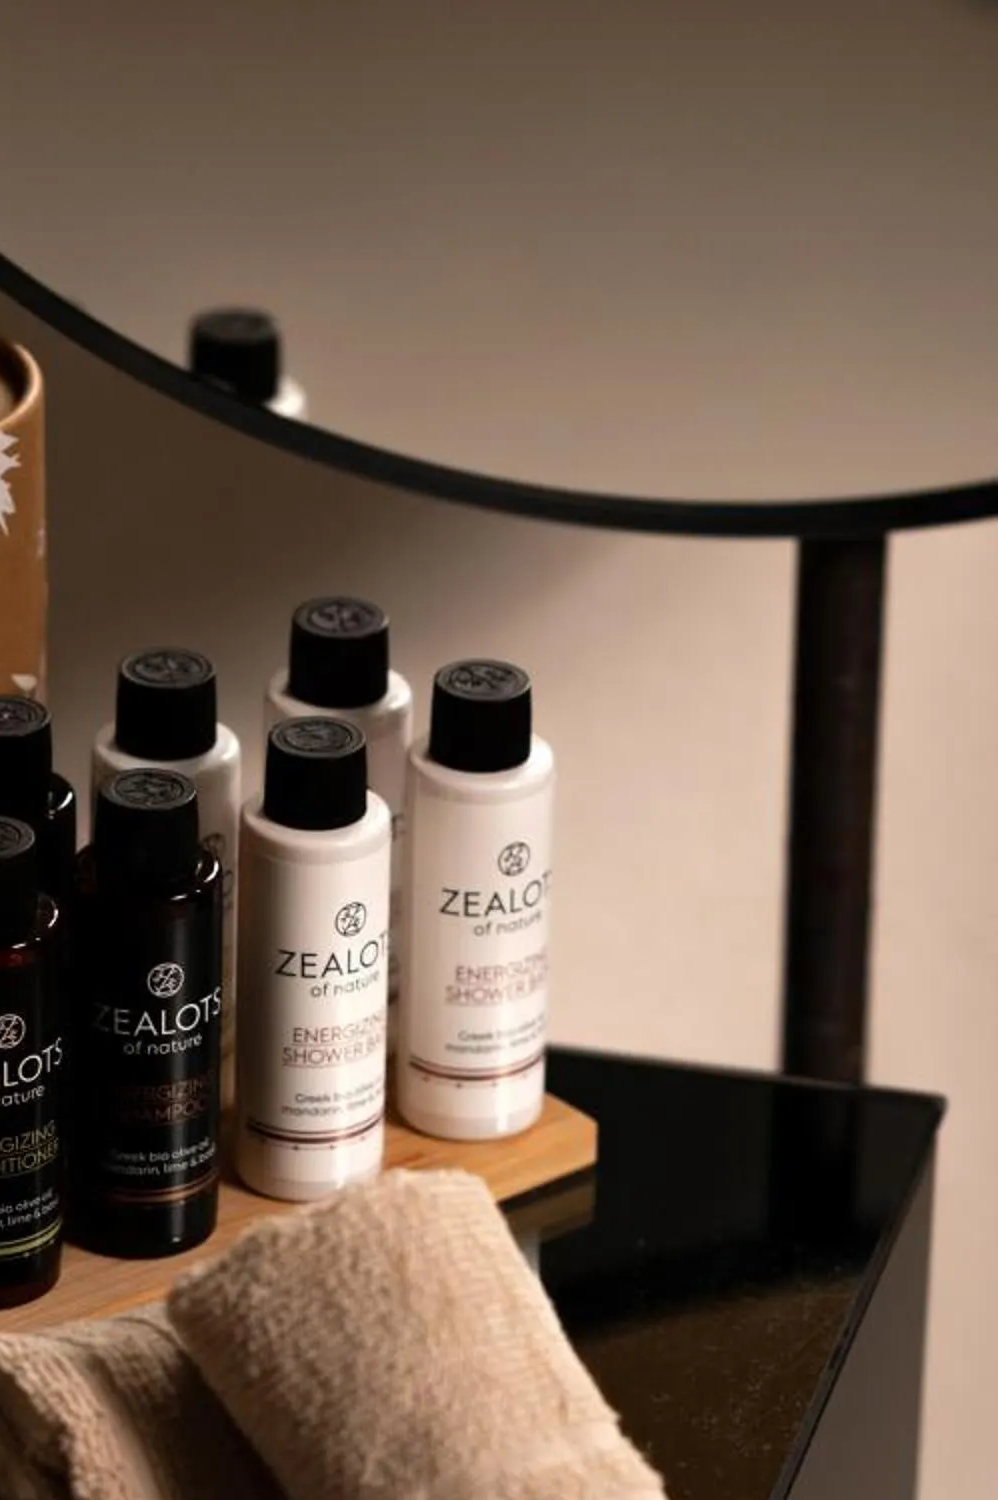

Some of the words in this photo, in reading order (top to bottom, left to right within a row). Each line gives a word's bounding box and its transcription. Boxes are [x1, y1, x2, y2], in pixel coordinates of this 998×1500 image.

[439, 869, 552, 918] ZEALOT
[473, 921, 493, 937] of
[275, 931, 387, 979] ZEALOT
[310, 981, 330, 998] of
[91, 985, 221, 1037] ZEALOTS
[122, 1040, 141, 1056] of
[146, 1033, 203, 1057] nature
